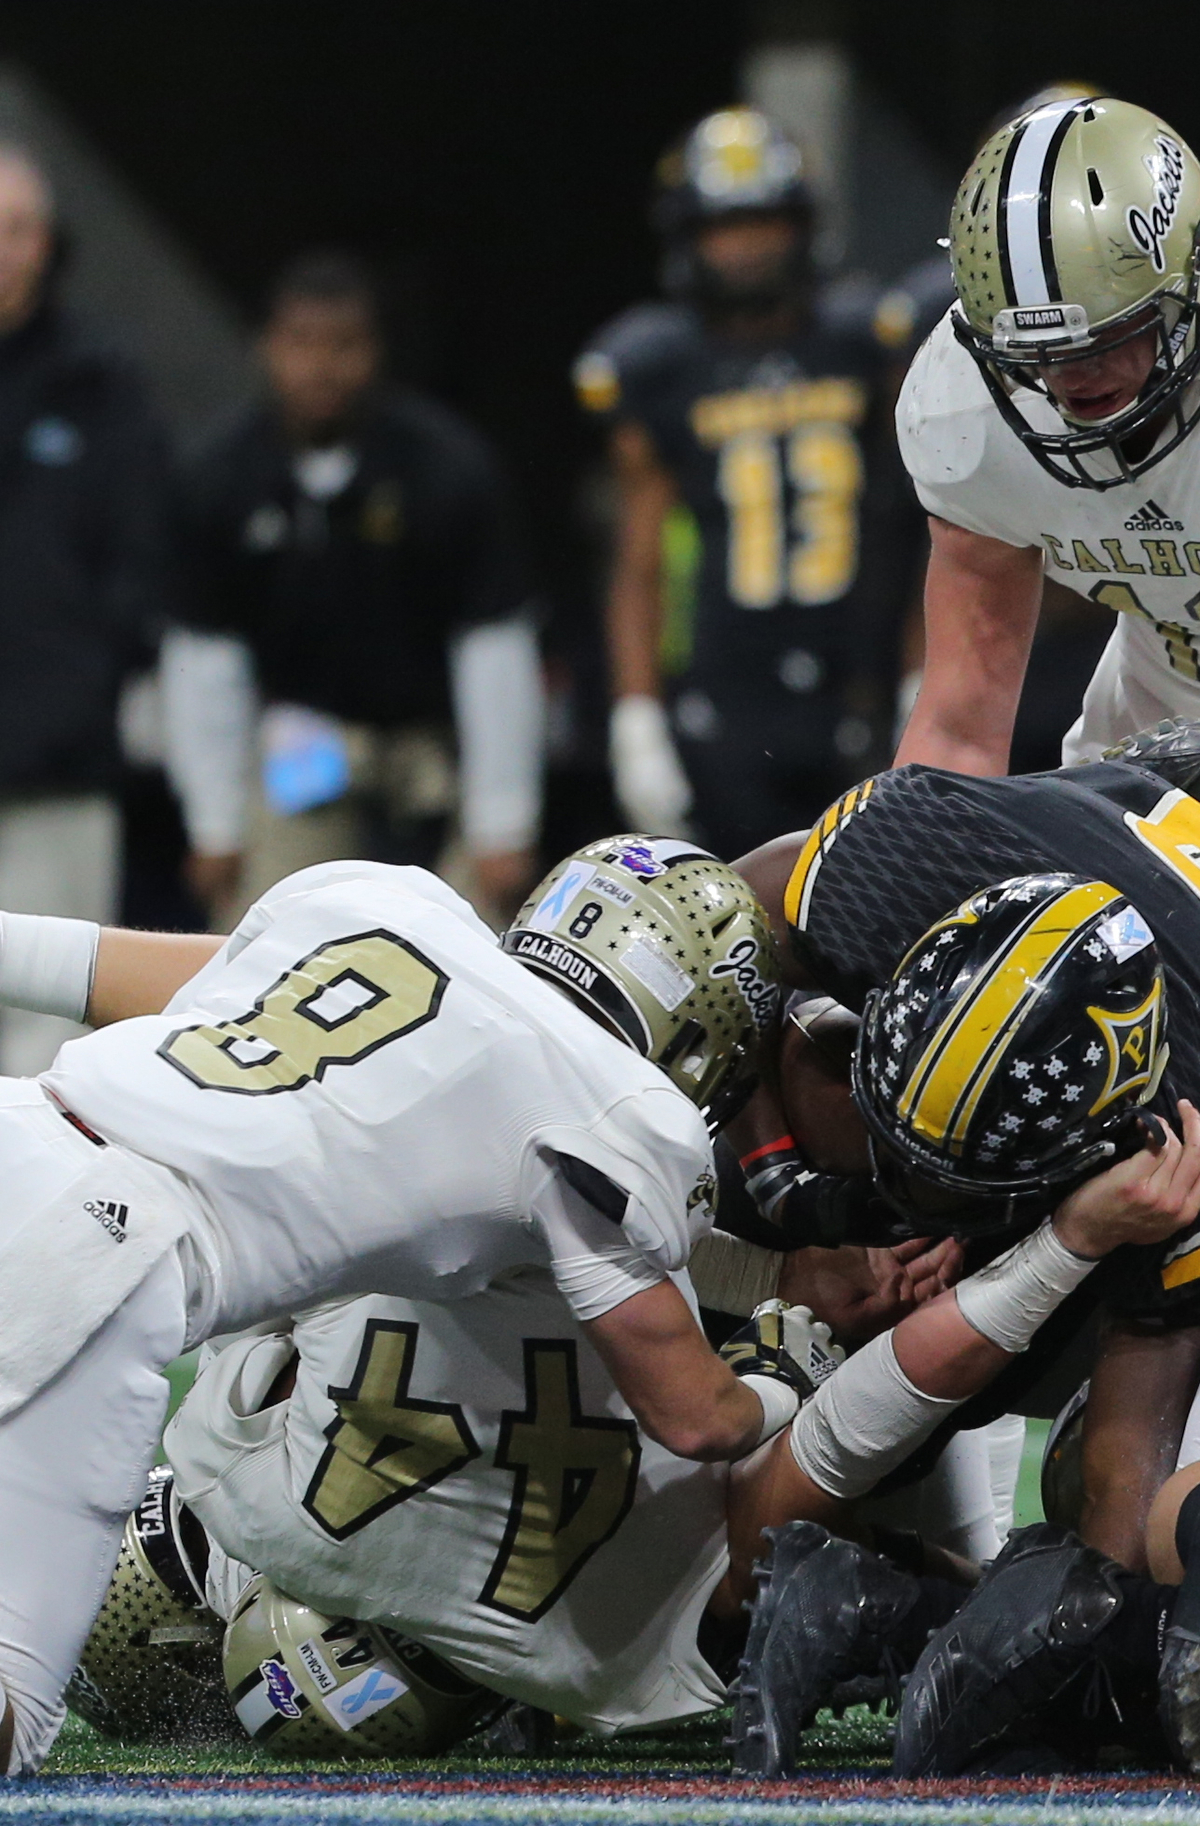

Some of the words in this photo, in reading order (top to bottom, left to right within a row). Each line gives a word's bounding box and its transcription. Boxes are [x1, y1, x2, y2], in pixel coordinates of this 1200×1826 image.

[1015, 310, 1063, 327] SWARM
[720, 424, 863, 609] 13
[1124, 519, 1185, 532] adidas
[592, 876, 633, 905] FW-CM-LM
[568, 901, 604, 940] 8
[517, 935, 599, 990] CALHOUN
[156, 928, 451, 1097] 8
[1120, 1025, 1146, 1072] P
[82, 1201, 128, 1244] adidas
[302, 1318, 641, 1625] 44
